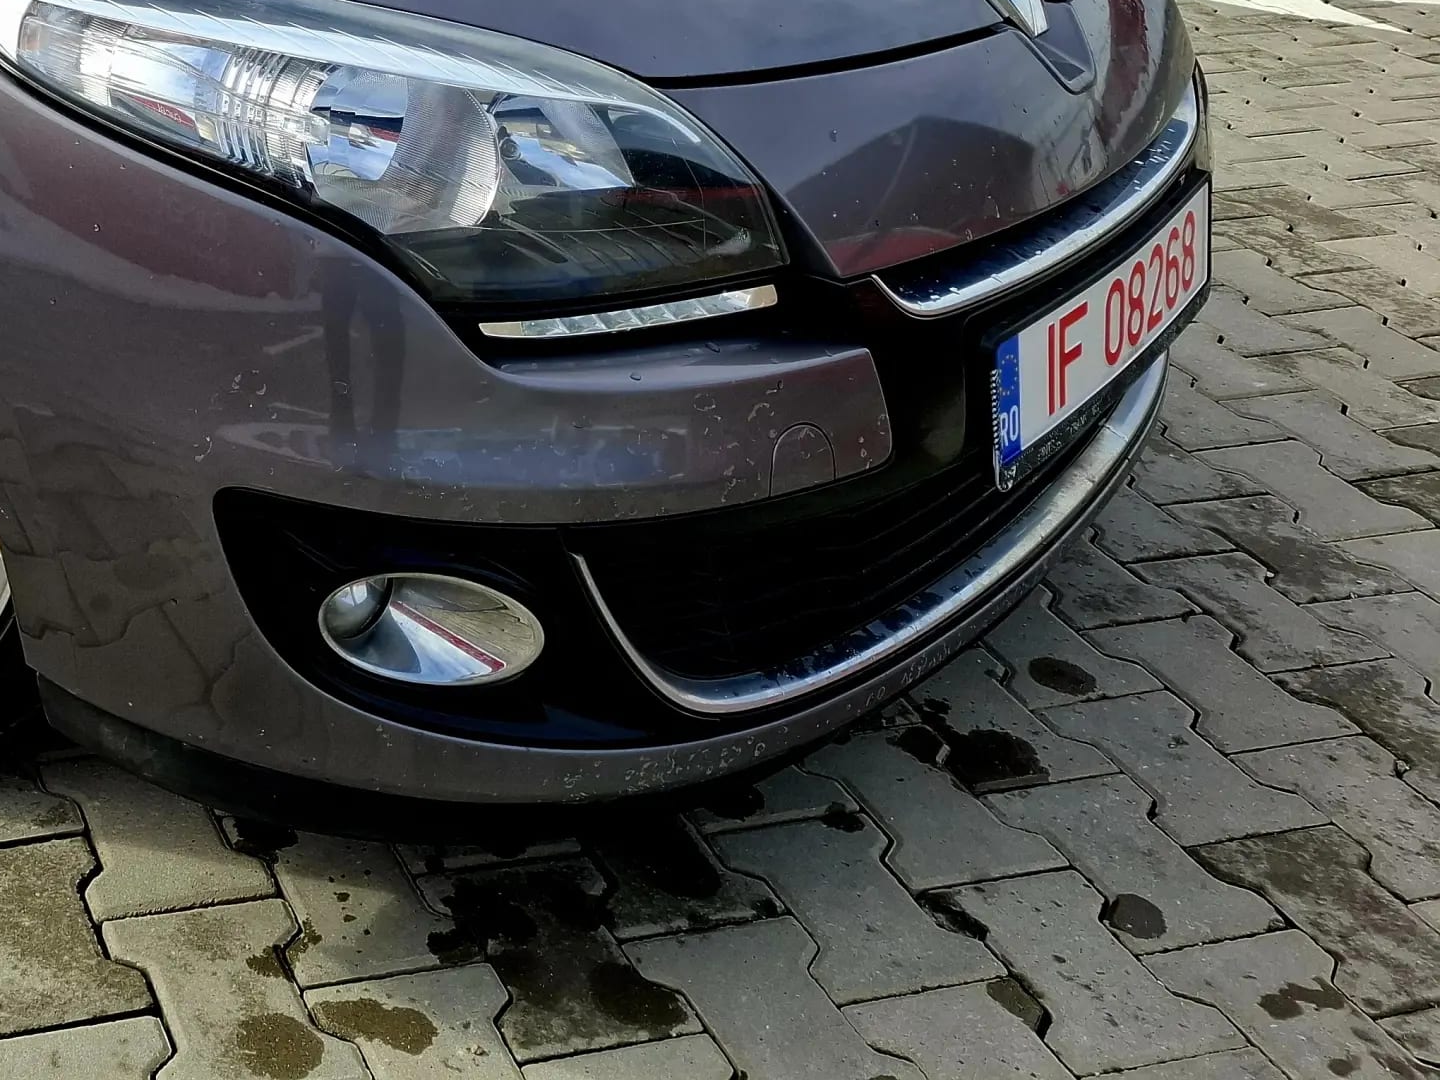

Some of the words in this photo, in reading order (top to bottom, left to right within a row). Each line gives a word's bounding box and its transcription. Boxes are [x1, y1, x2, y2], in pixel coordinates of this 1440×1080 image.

[1047, 301, 1088, 418] IF
[1104, 210, 1196, 366] 08268
[1000, 405, 1019, 447] RO
